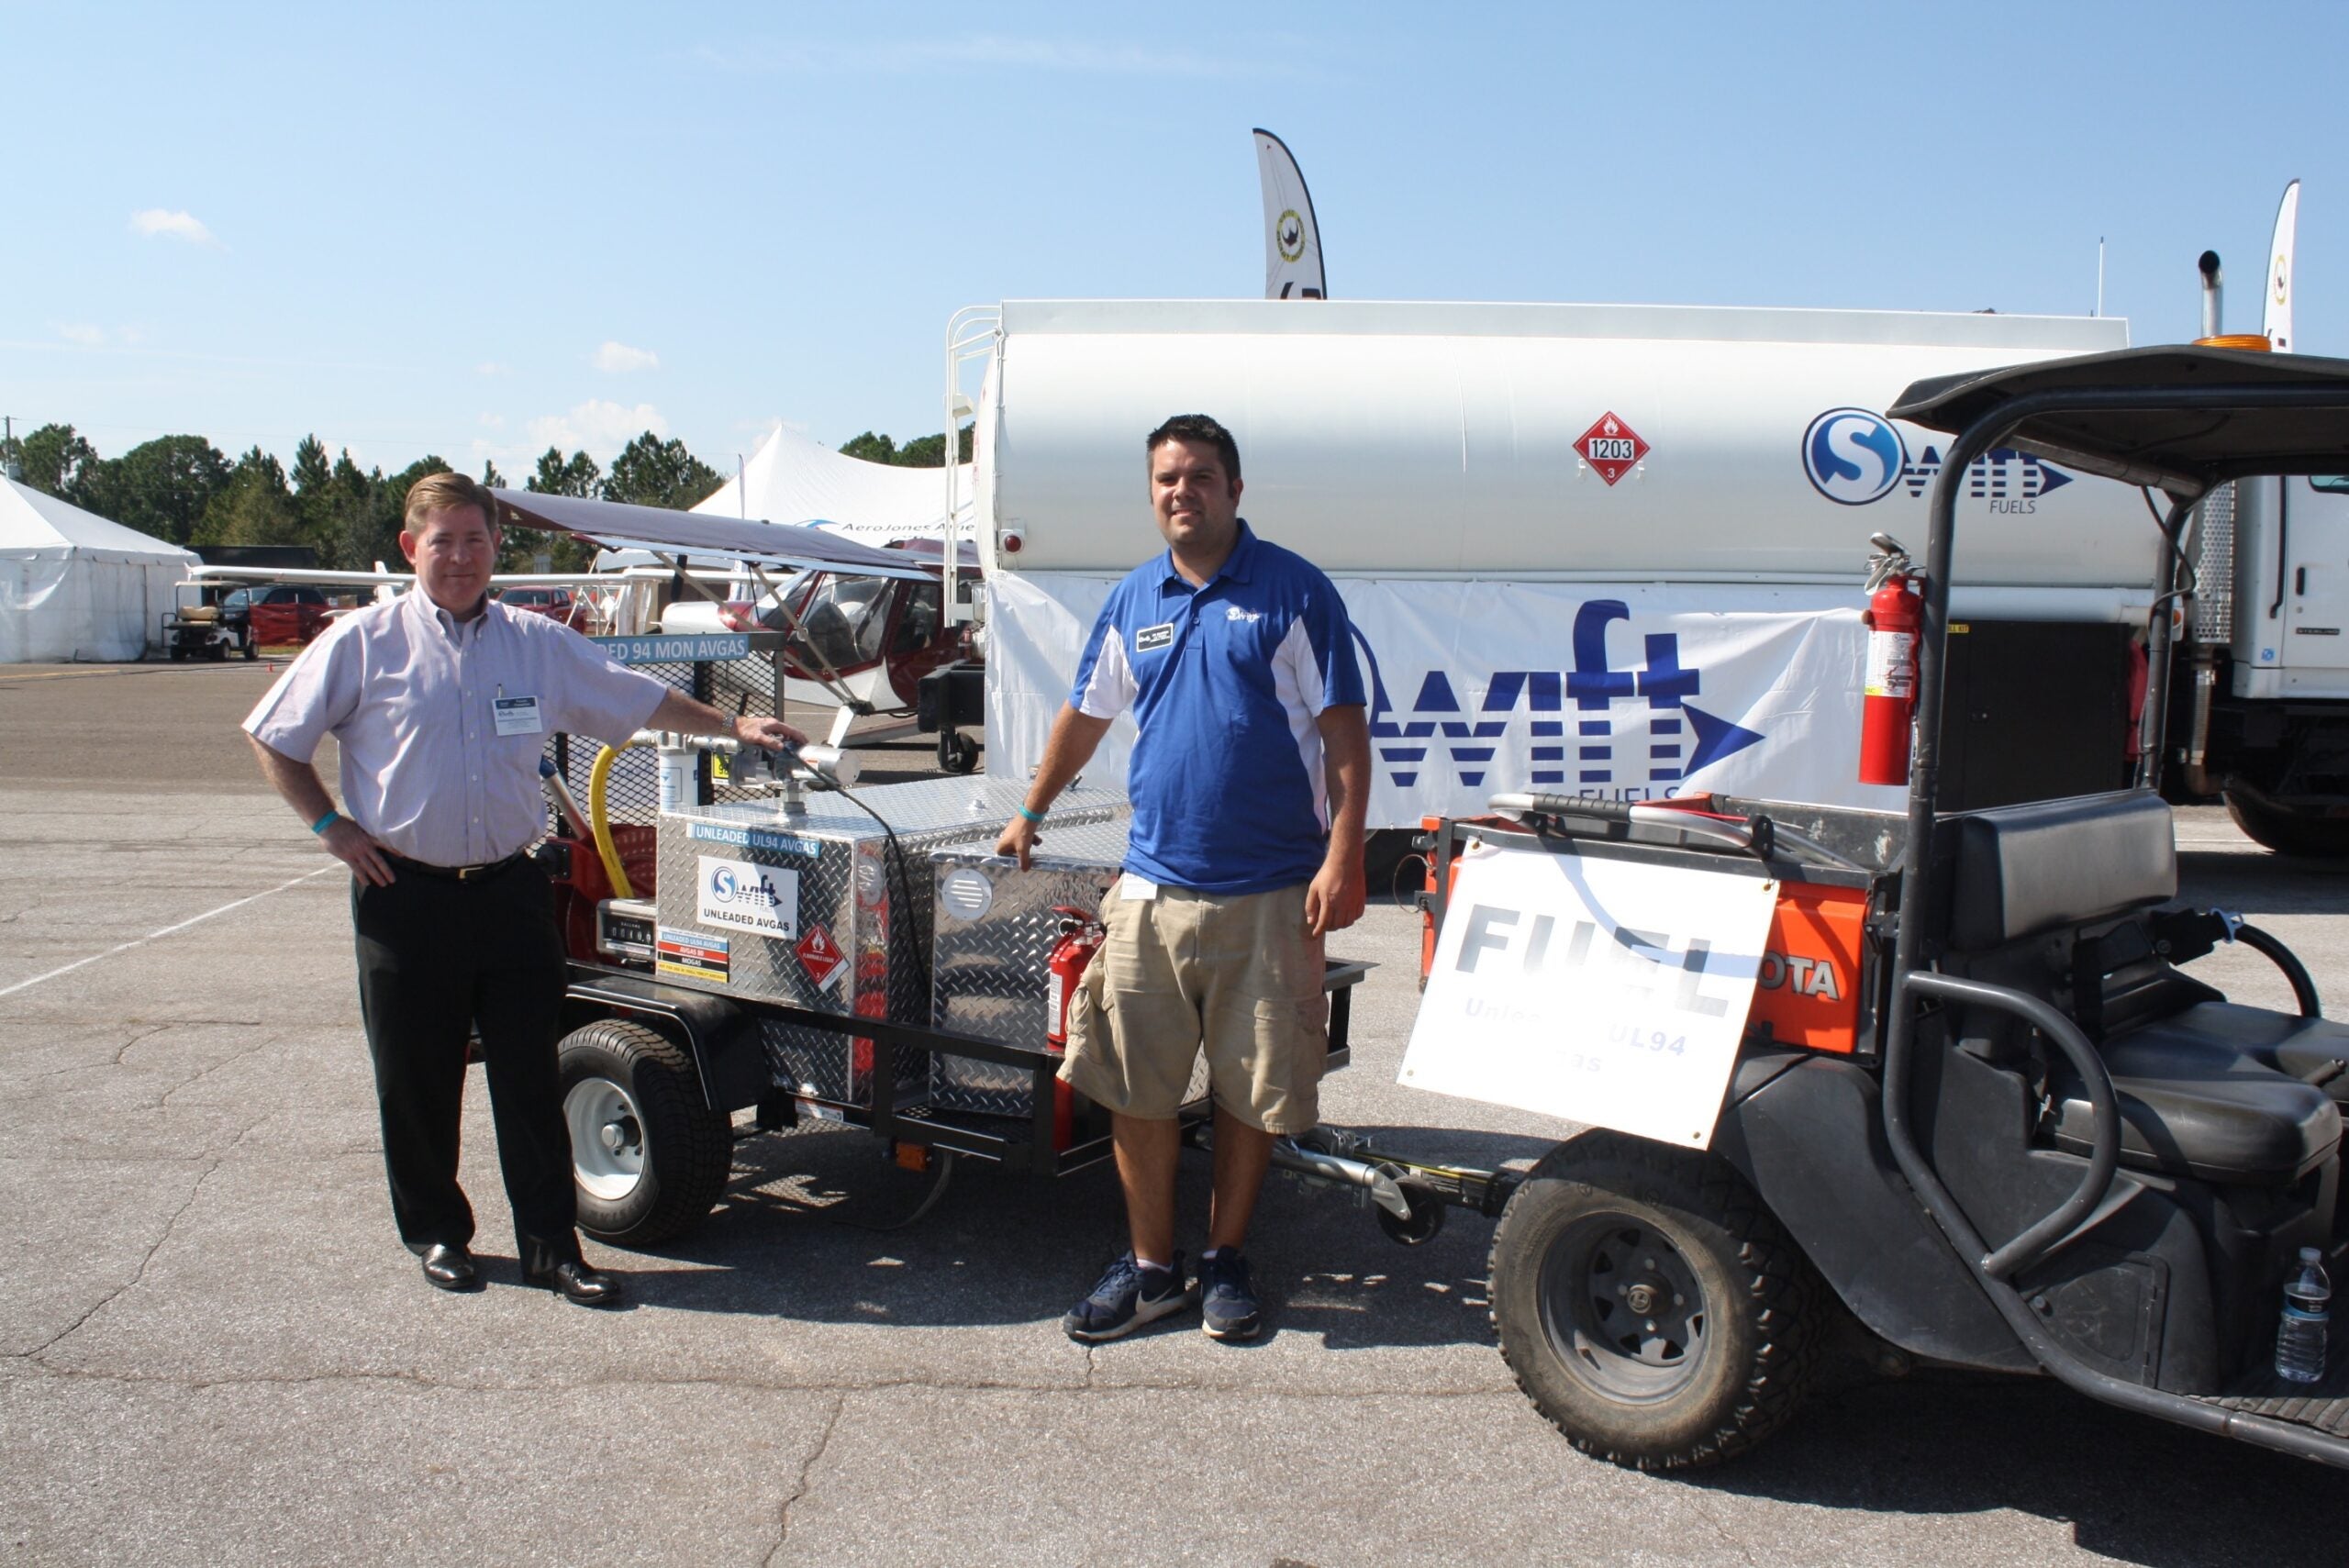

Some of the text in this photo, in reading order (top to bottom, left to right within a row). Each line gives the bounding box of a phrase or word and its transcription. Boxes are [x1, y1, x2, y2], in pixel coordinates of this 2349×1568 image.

[1591, 439, 1632, 459] 1203
[1608, 468, 1615, 478] 3
[1989, 500, 2036, 514] FUELS
[632, 642, 651, 659] 94
[655, 641, 694, 659] MON
[697, 639, 745, 657] AVGAS
[696, 827, 817, 854] UNLEADED UL94 AVGAS
[704, 908, 790, 931] UNLEADED AVGAS
[681, 957, 702, 966] MOGAS
[1759, 951, 1840, 1001] OTA
[1609, 1022, 1687, 1056] UL94
